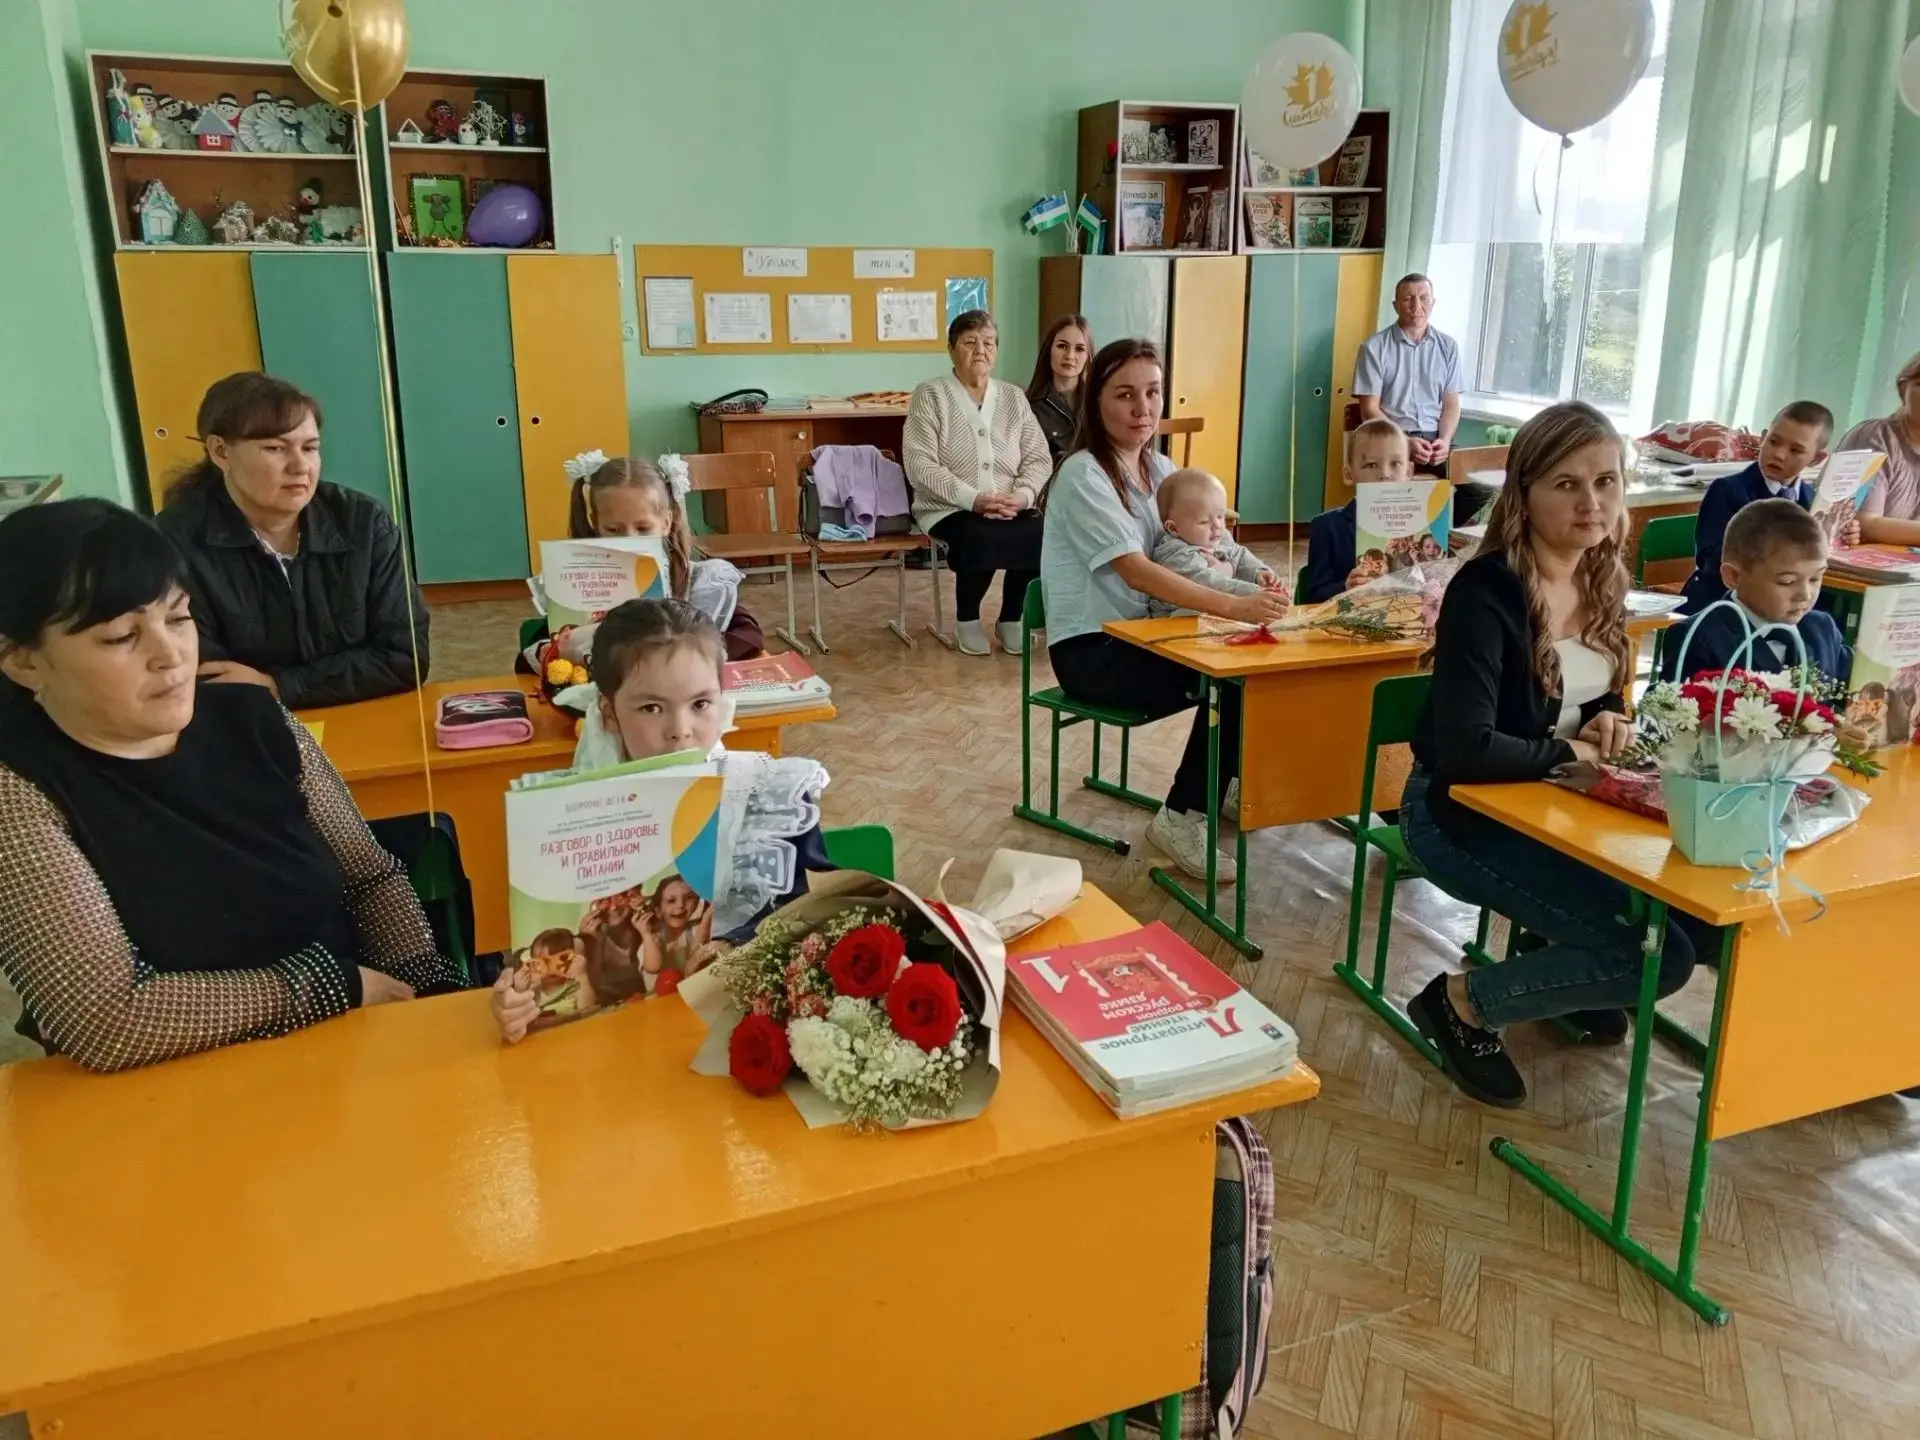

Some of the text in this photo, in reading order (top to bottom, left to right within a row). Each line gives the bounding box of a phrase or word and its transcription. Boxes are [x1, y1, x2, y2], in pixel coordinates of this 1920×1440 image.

[540, 835, 592, 856] РАЗГОВОР
[596, 833, 603, 846] О
[607, 823, 660, 844] ЗДОРОВЬЕ
[561, 842, 641, 868] И ПРАВИЛЬНОМ
[577, 858, 625, 880] ПИТАНИИ
[1098, 991, 1148, 1012] языке
[1102, 996, 1171, 1020] русском
[1135, 1003, 1182, 1021] родном
[1130, 1014, 1189, 1032] чтение
